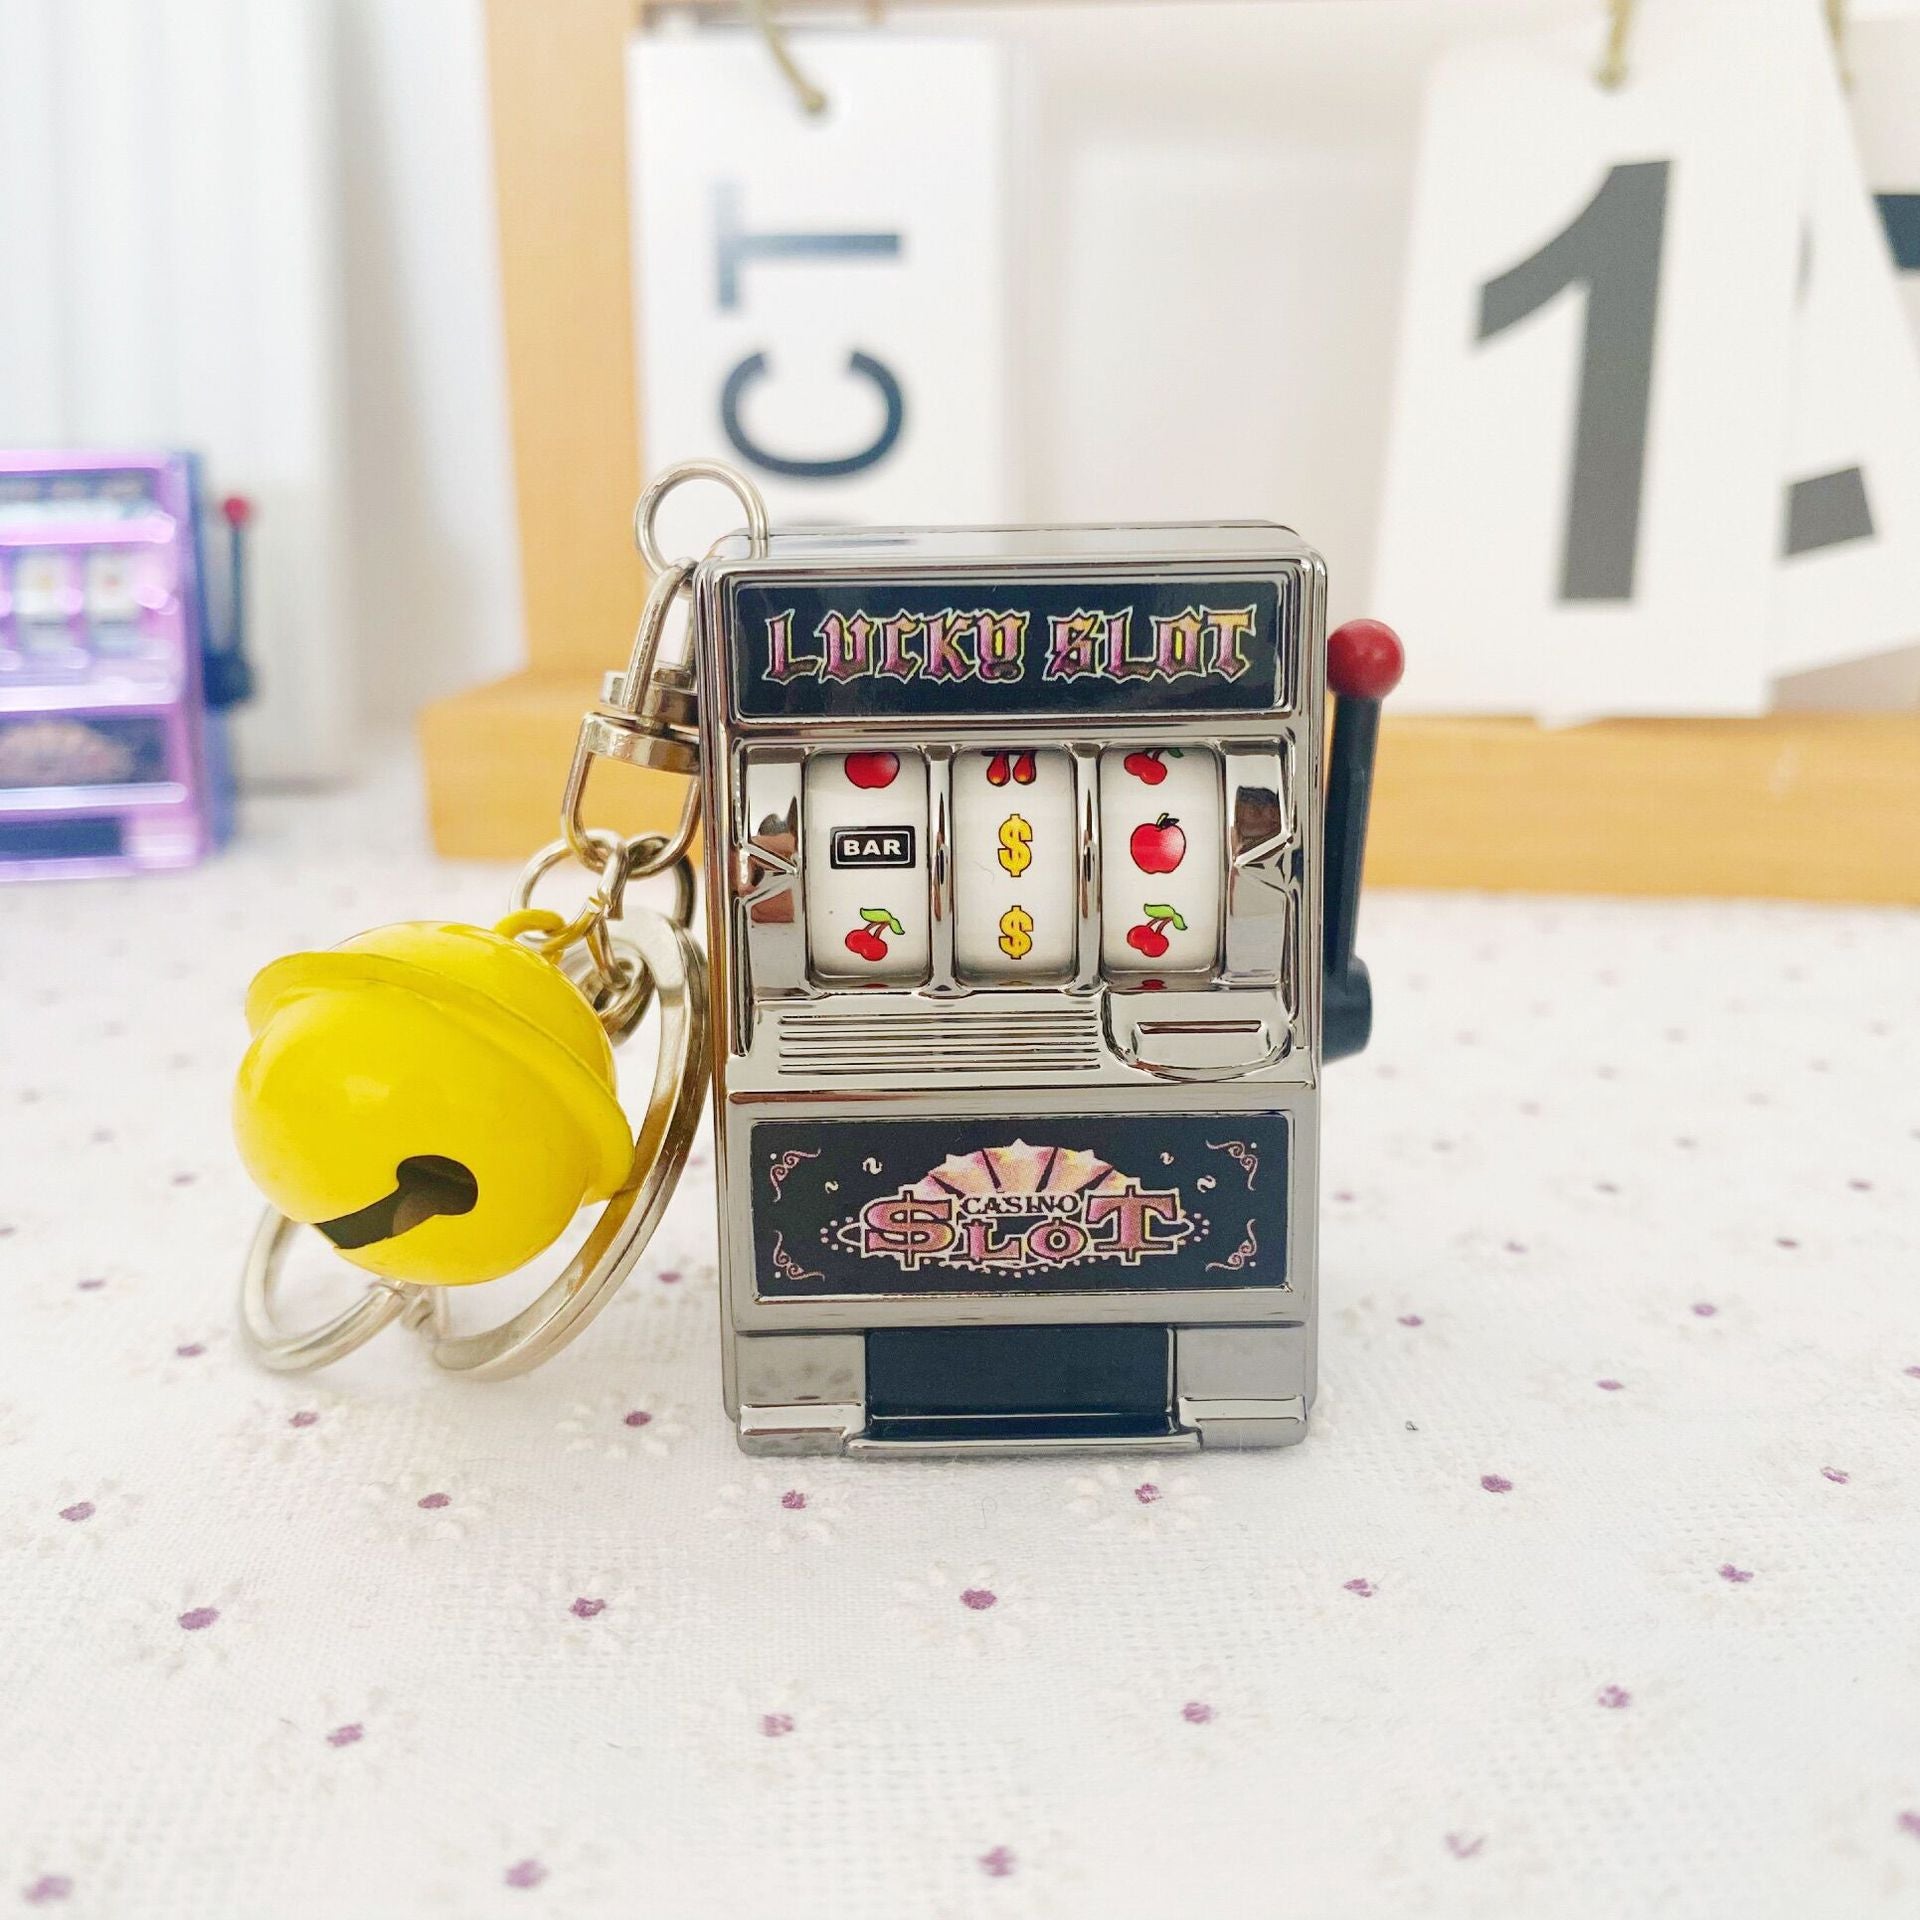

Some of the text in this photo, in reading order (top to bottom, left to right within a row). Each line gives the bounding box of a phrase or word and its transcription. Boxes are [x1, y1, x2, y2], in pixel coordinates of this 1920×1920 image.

[714, 178, 904, 528] CT
[1474, 159, 1671, 604] 1
[765, 604, 1257, 685] LUCKY SLOT
[843, 838, 903, 857] BAR
[960, 1193, 1080, 1215] CASINO
